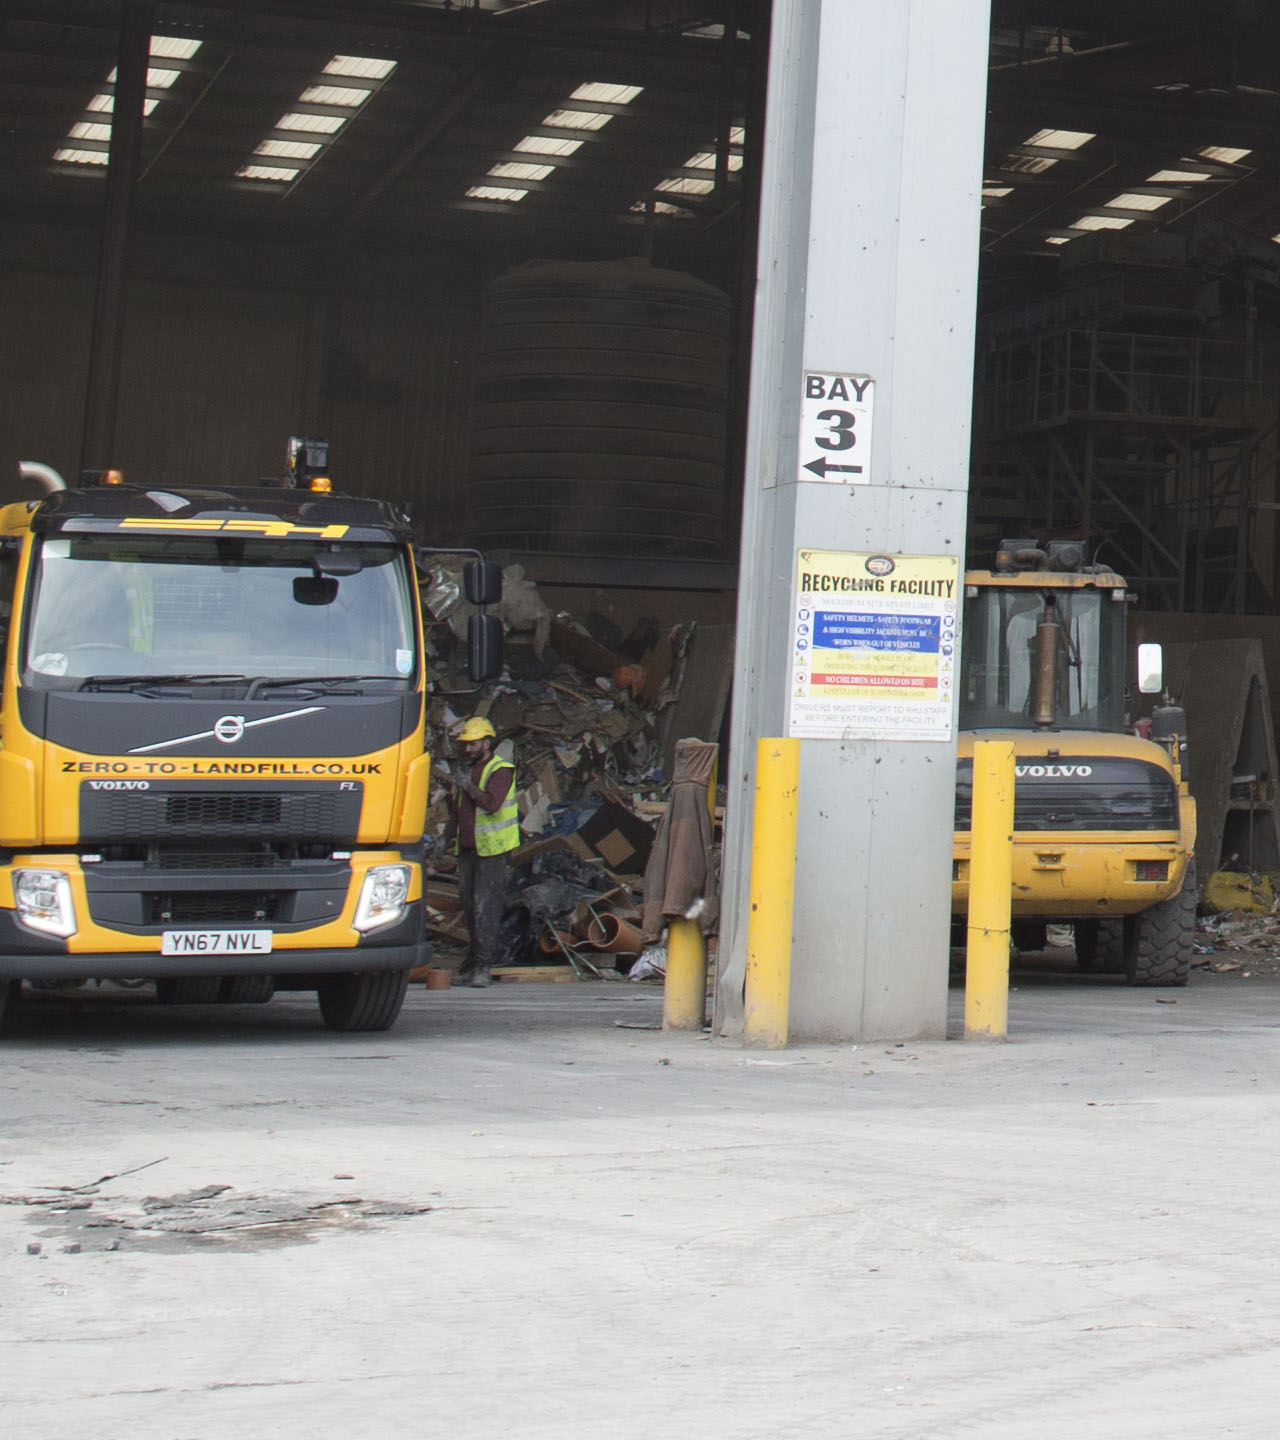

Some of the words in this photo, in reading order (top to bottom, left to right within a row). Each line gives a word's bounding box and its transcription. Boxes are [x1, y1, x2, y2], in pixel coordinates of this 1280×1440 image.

[805, 375, 871, 402] BAY
[814, 409, 856, 451] 3
[801, 573, 885, 593] RECYCLING
[890, 579, 954, 598] FACILITY
[823, 614, 846, 622] SAFETY
[836, 676, 868, 684] CHILDREN
[869, 677, 900, 685] ALLOWED
[794, 703, 831, 712] DRIVERS
[858, 705, 891, 713] REPORT
[805, 714, 839, 722] BEFORE
[841, 714, 884, 724] ENTERING
[1015, 765, 1092, 777] VOLVO
[88, 781, 150, 791] VOLVO
[339, 781, 358, 791] FL
[172, 934, 221, 951] YN67
[226, 933, 262, 950] NVL
